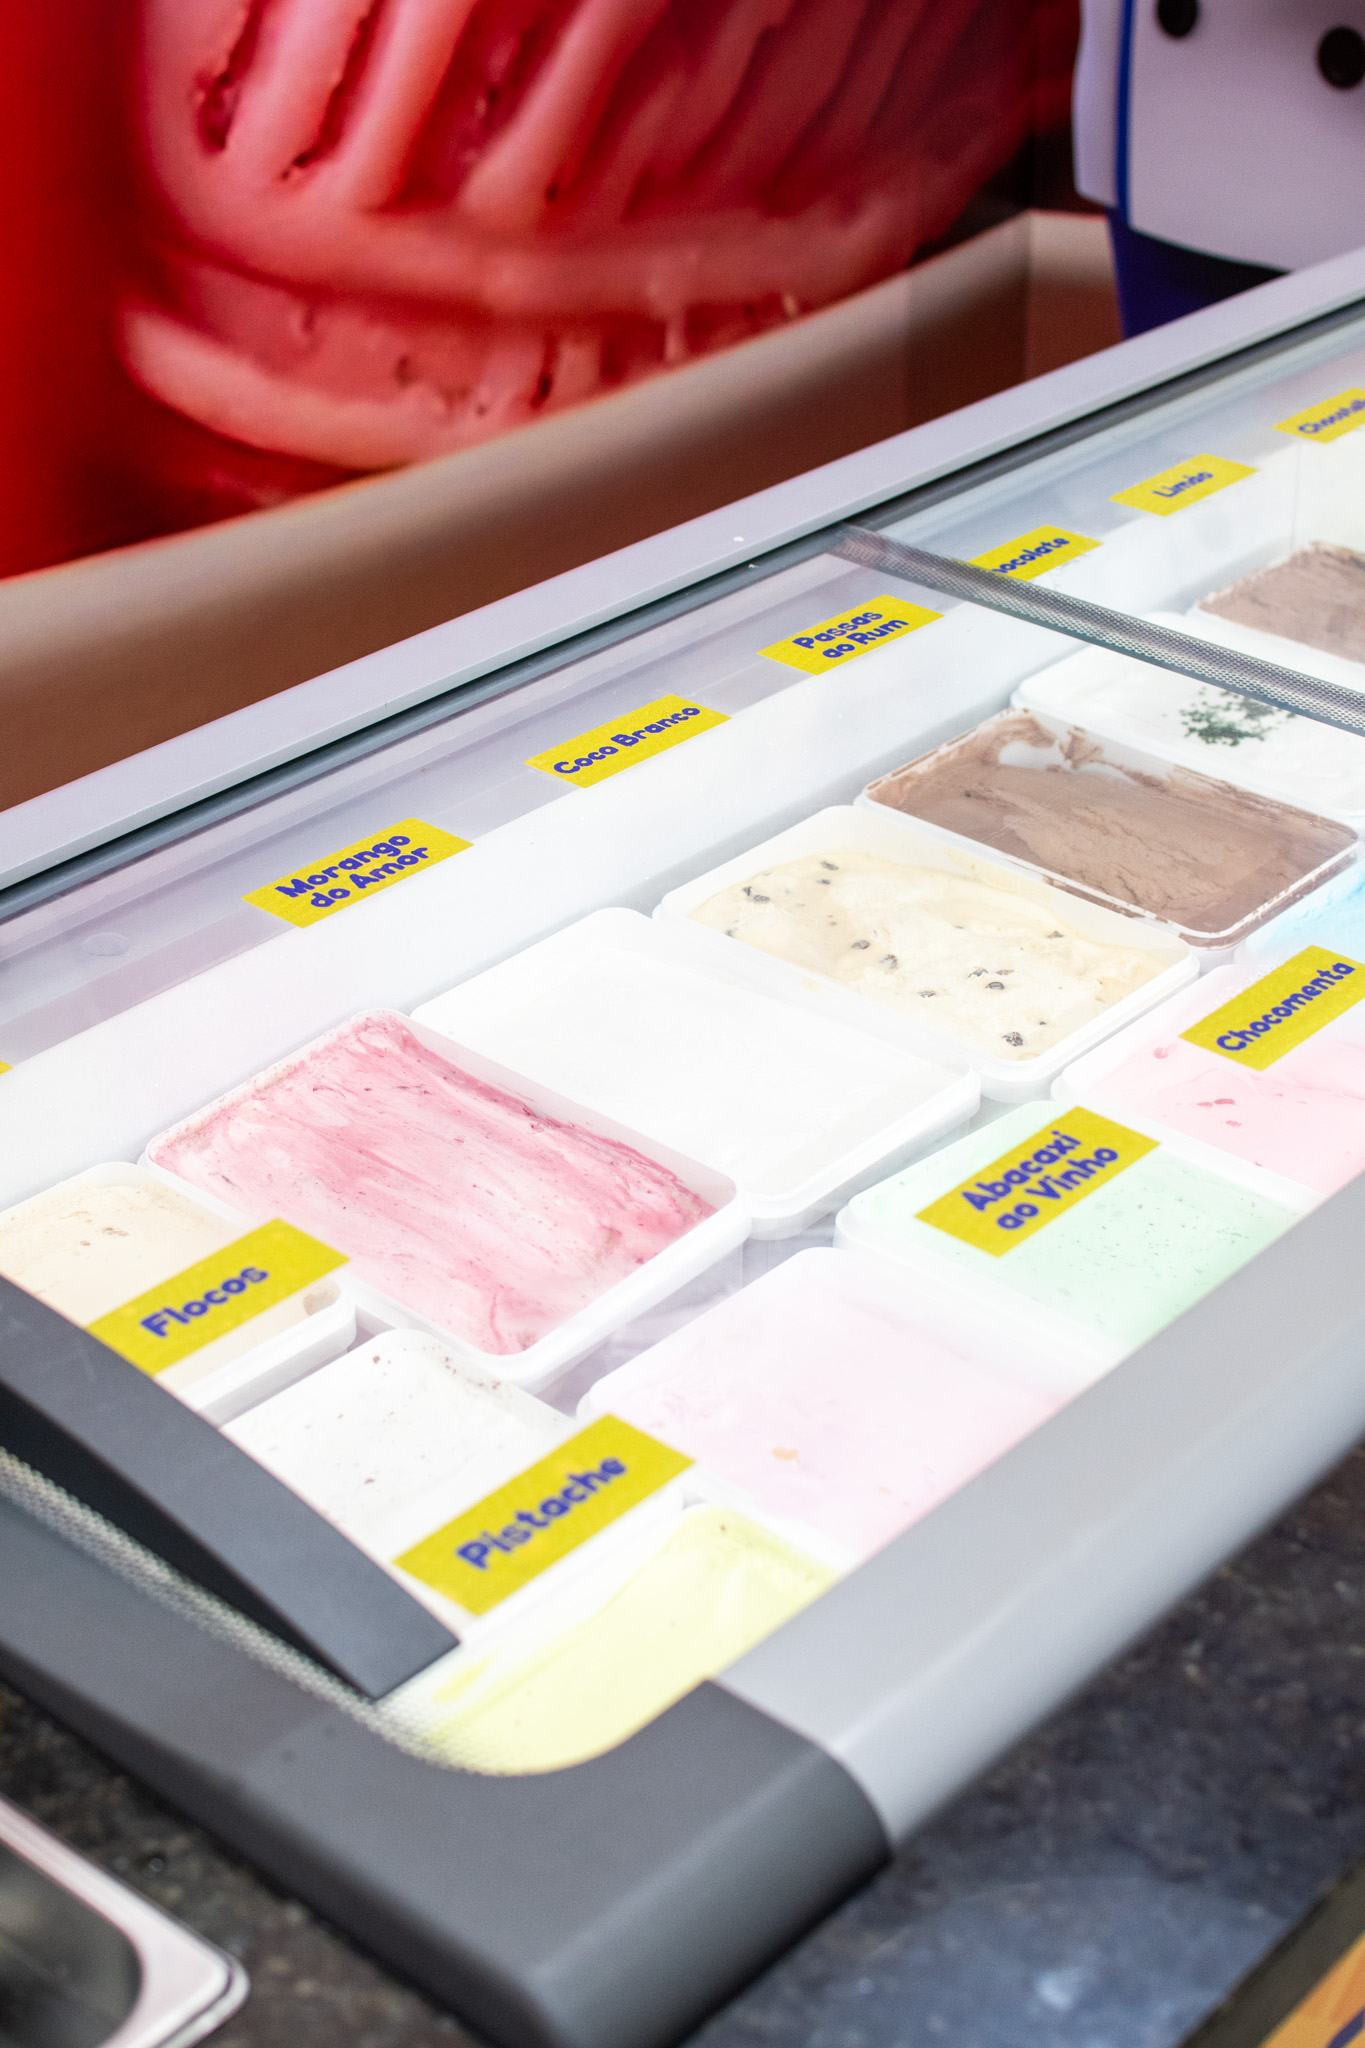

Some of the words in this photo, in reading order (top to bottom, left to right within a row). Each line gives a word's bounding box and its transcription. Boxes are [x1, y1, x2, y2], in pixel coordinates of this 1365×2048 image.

[991, 537, 1070, 574] ocolate
[791, 611, 883, 650] Passas
[822, 643, 856, 659] ao
[846, 619, 910, 645] Rum
[553, 745, 619, 774] Coco
[610, 707, 701, 747] Branco
[274, 835, 411, 898] Morango
[310, 888, 351, 908] do
[349, 847, 429, 889] Amor
[1216, 962, 1356, 1052] Chocomenta
[961, 1130, 1082, 1212] Abacaxi
[996, 1202, 1039, 1230] ao
[1024, 1147, 1119, 1200] Vinho
[139, 1266, 269, 1338] Flocos
[455, 1457, 627, 1571] Pistache
